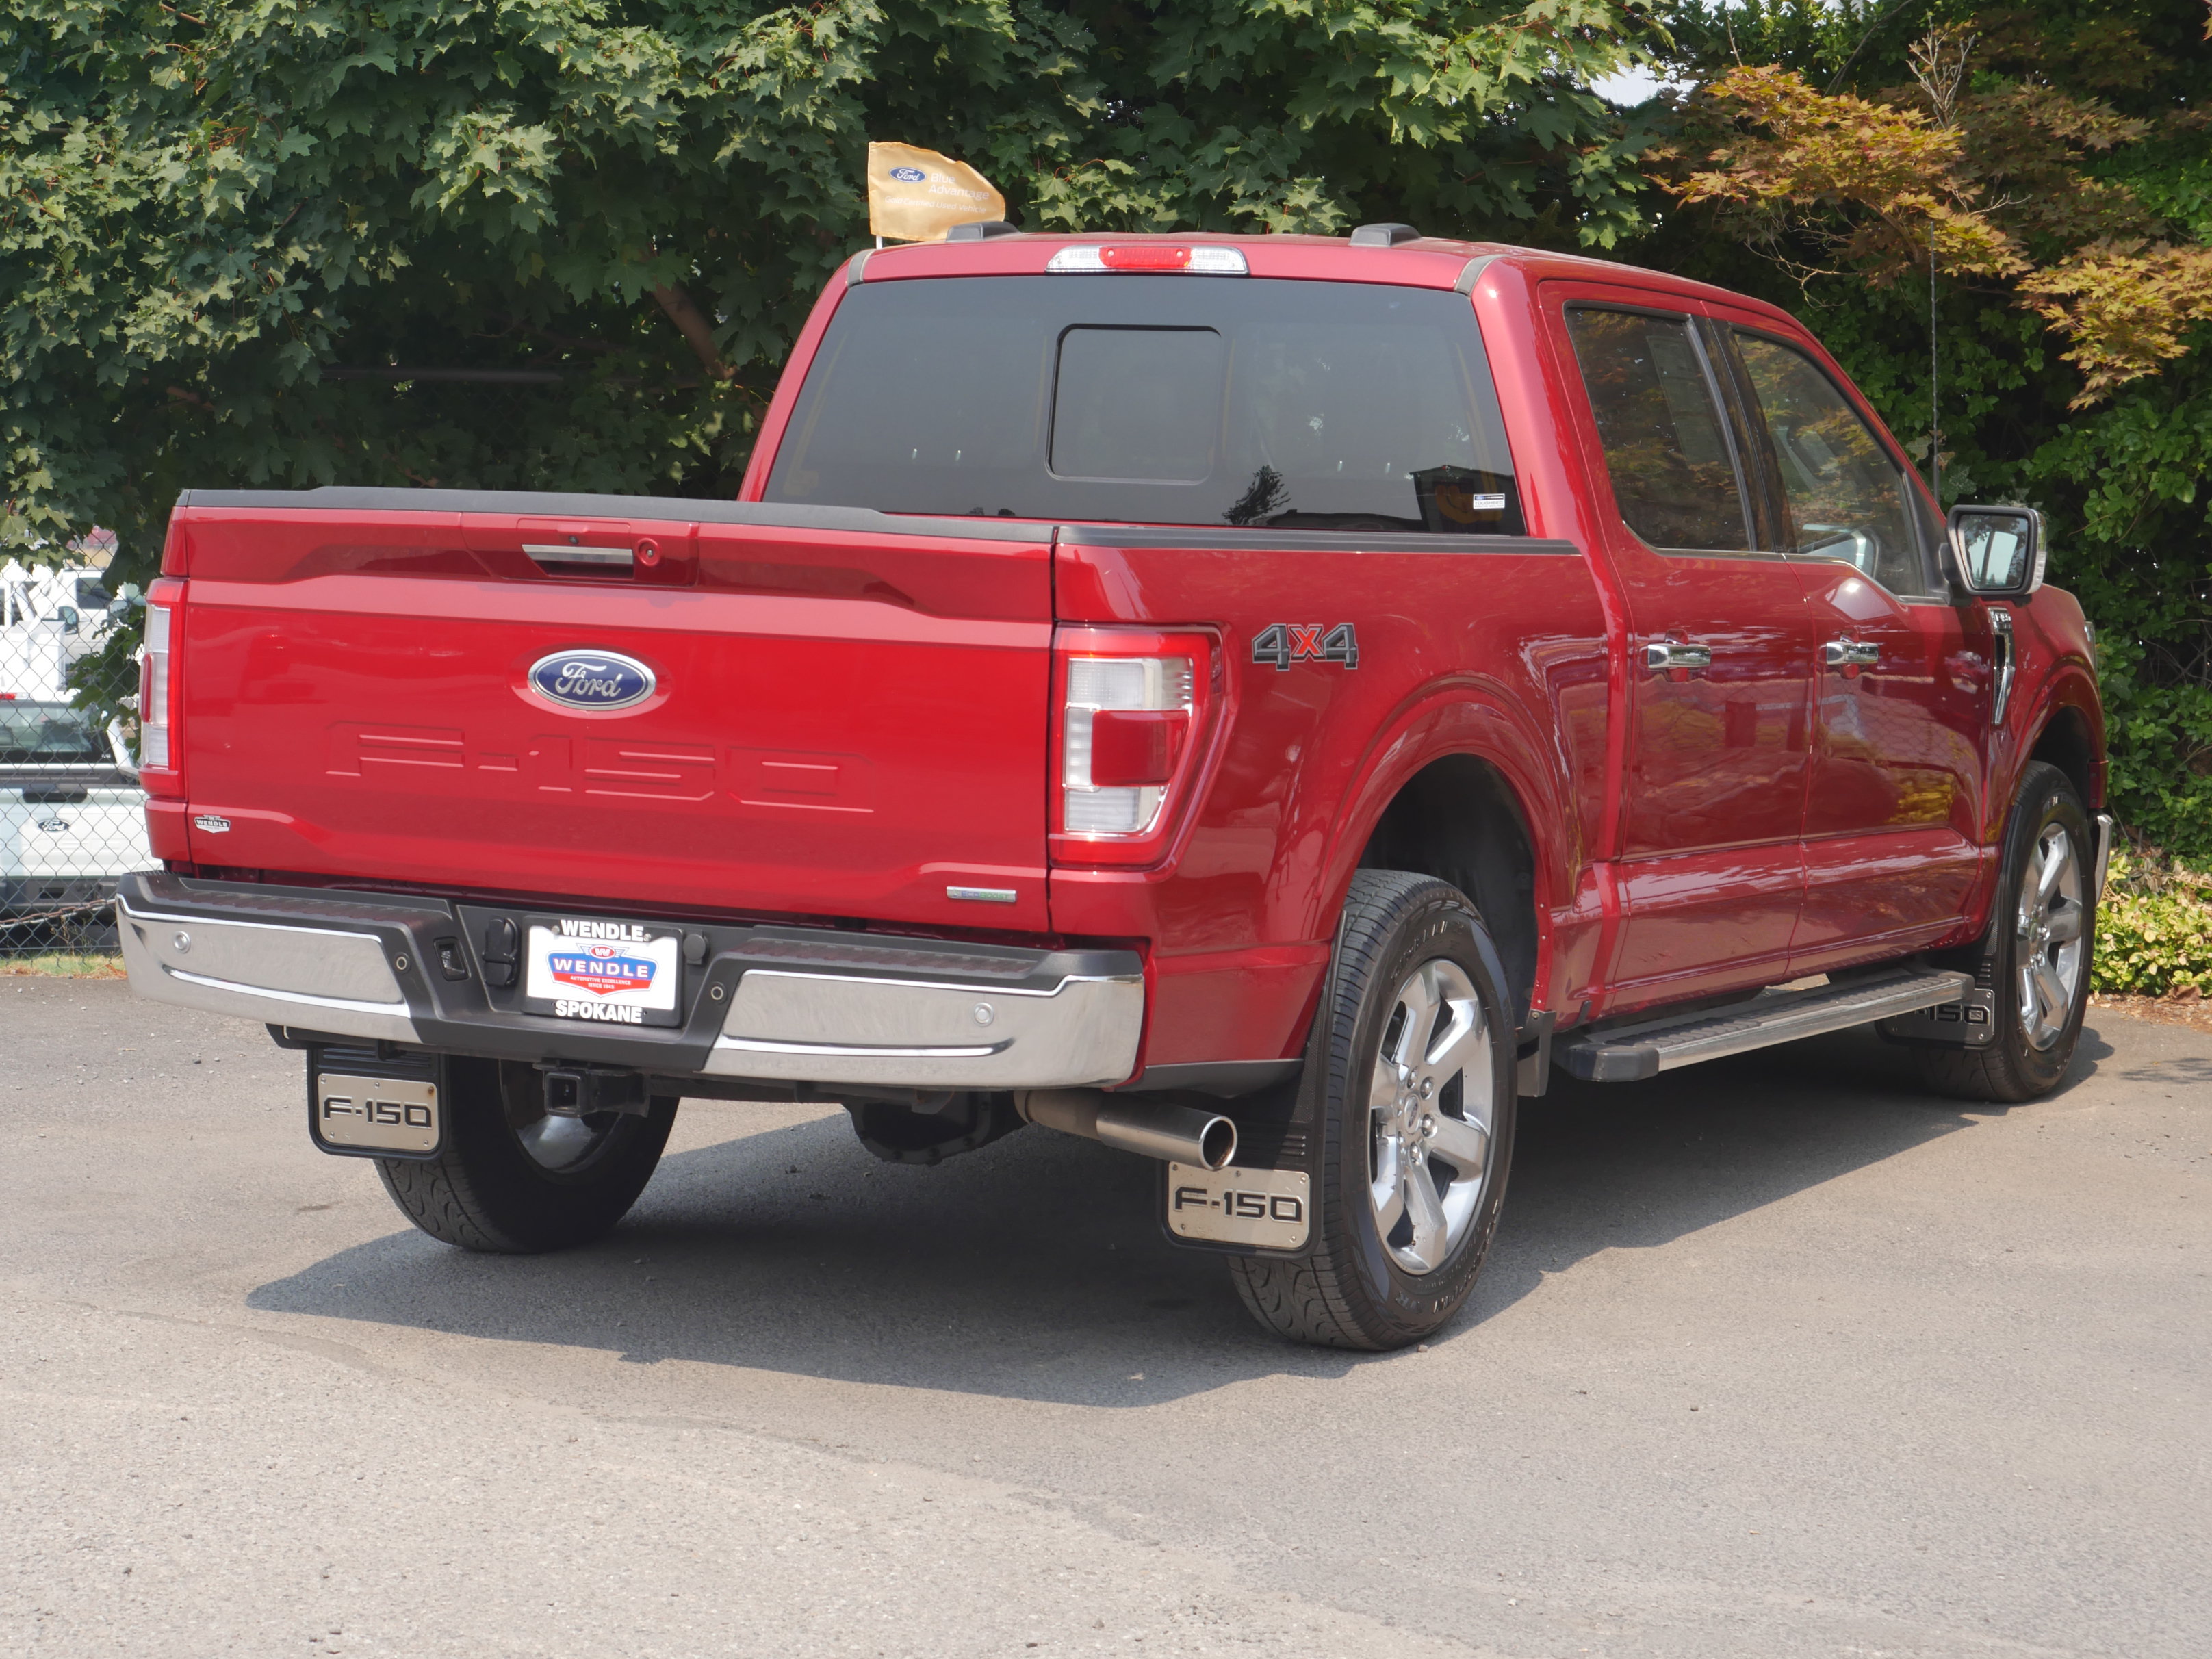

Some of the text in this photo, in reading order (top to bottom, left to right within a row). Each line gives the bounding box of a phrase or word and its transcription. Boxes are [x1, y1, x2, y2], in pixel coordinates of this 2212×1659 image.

[897, 168, 955, 183] Ford Blue
[928, 184, 990, 201] Advantage
[903, 198, 935, 207] Certified
[958, 205, 986, 214] Vehicle
[555, 662, 623, 697] Ford
[325, 720, 874, 813] F-150
[42, 821, 65, 831] Ford
[196, 819, 227, 827] WENDLE
[561, 919, 644, 942] WENDLE
[553, 958, 648, 977] WENDLE
[555, 1000, 642, 1023] SPOKANE
[324, 1095, 433, 1129] F-150
[1174, 1185, 1302, 1224] F-150
